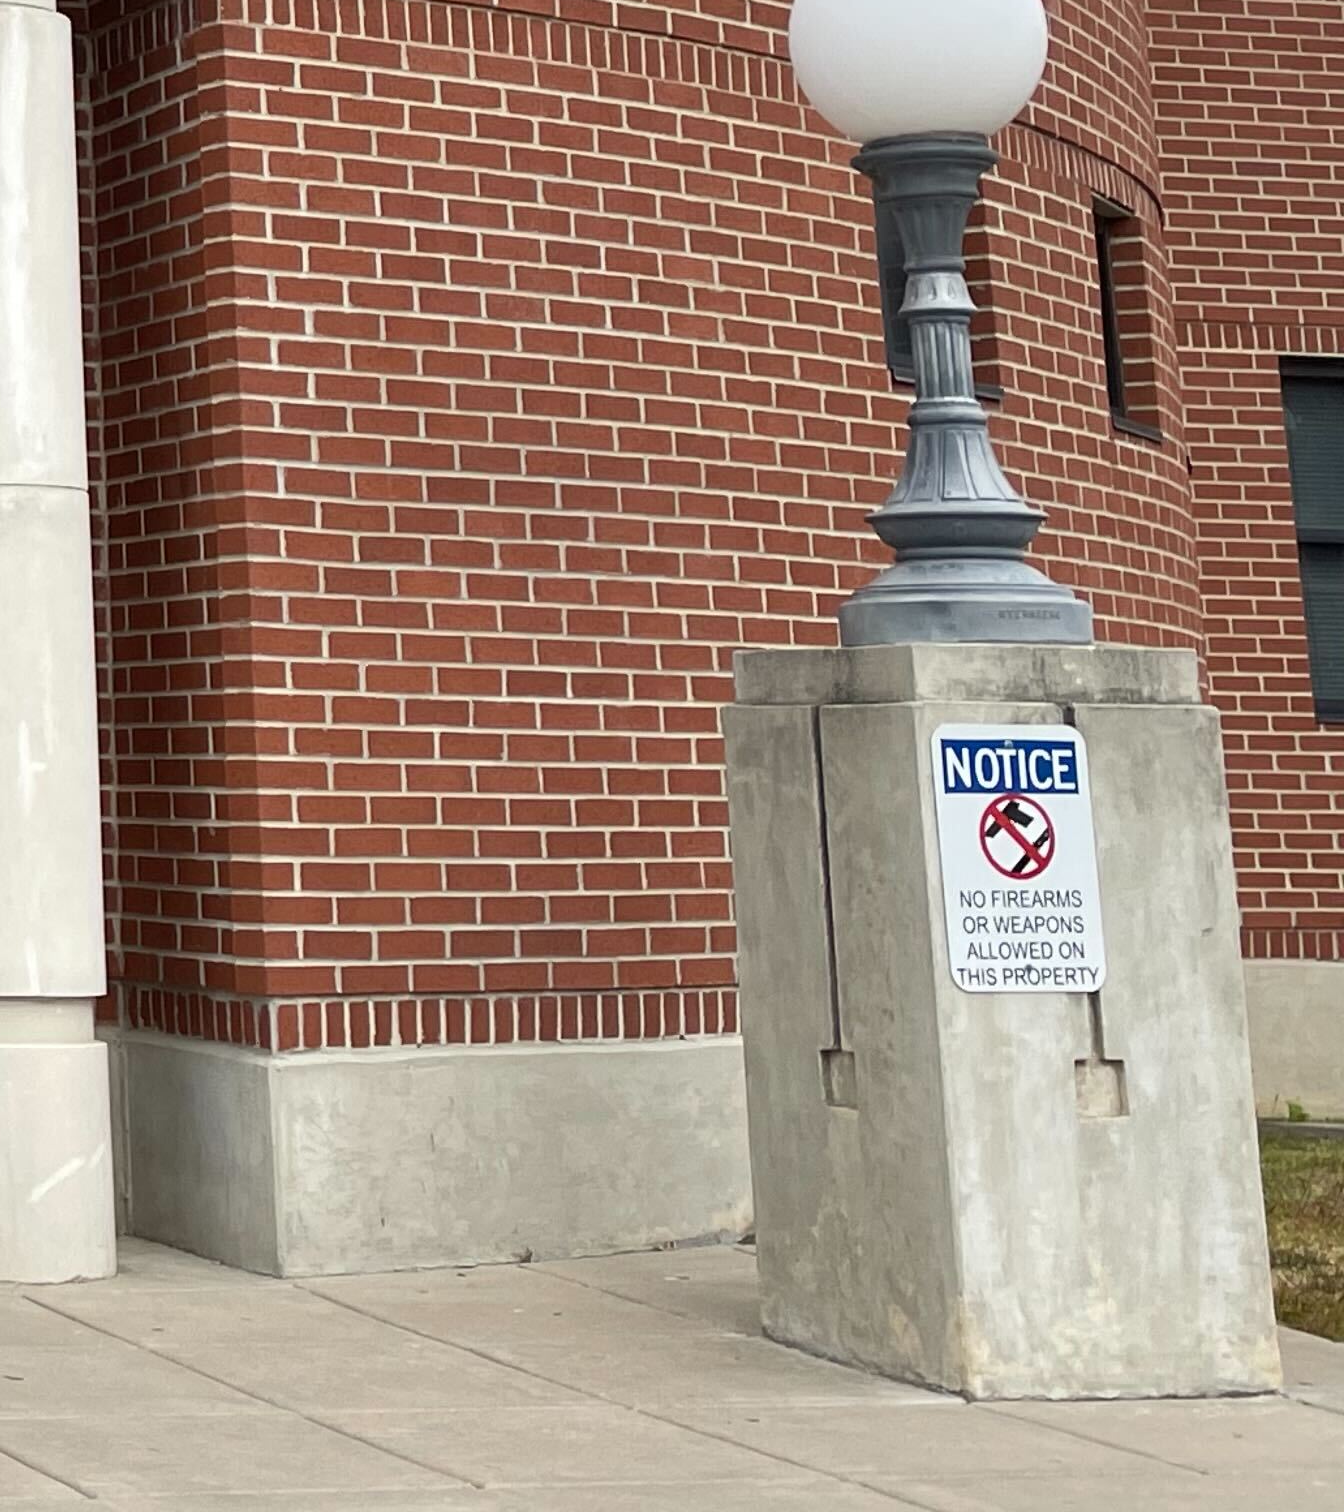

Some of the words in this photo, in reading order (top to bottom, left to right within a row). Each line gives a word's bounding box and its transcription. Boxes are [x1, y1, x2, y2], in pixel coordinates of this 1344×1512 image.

[945, 747, 1076, 790] NOTICE
[960, 890, 986, 908] NO
[992, 890, 1082, 908] FIREARMS
[963, 916, 988, 934] OR
[995, 916, 1084, 934] WEAPONS
[967, 942, 1053, 960] ALLOWED
[1059, 942, 1085, 959] ON
[957, 968, 997, 985] THIS
[1003, 967, 1099, 985] PROPERTY
